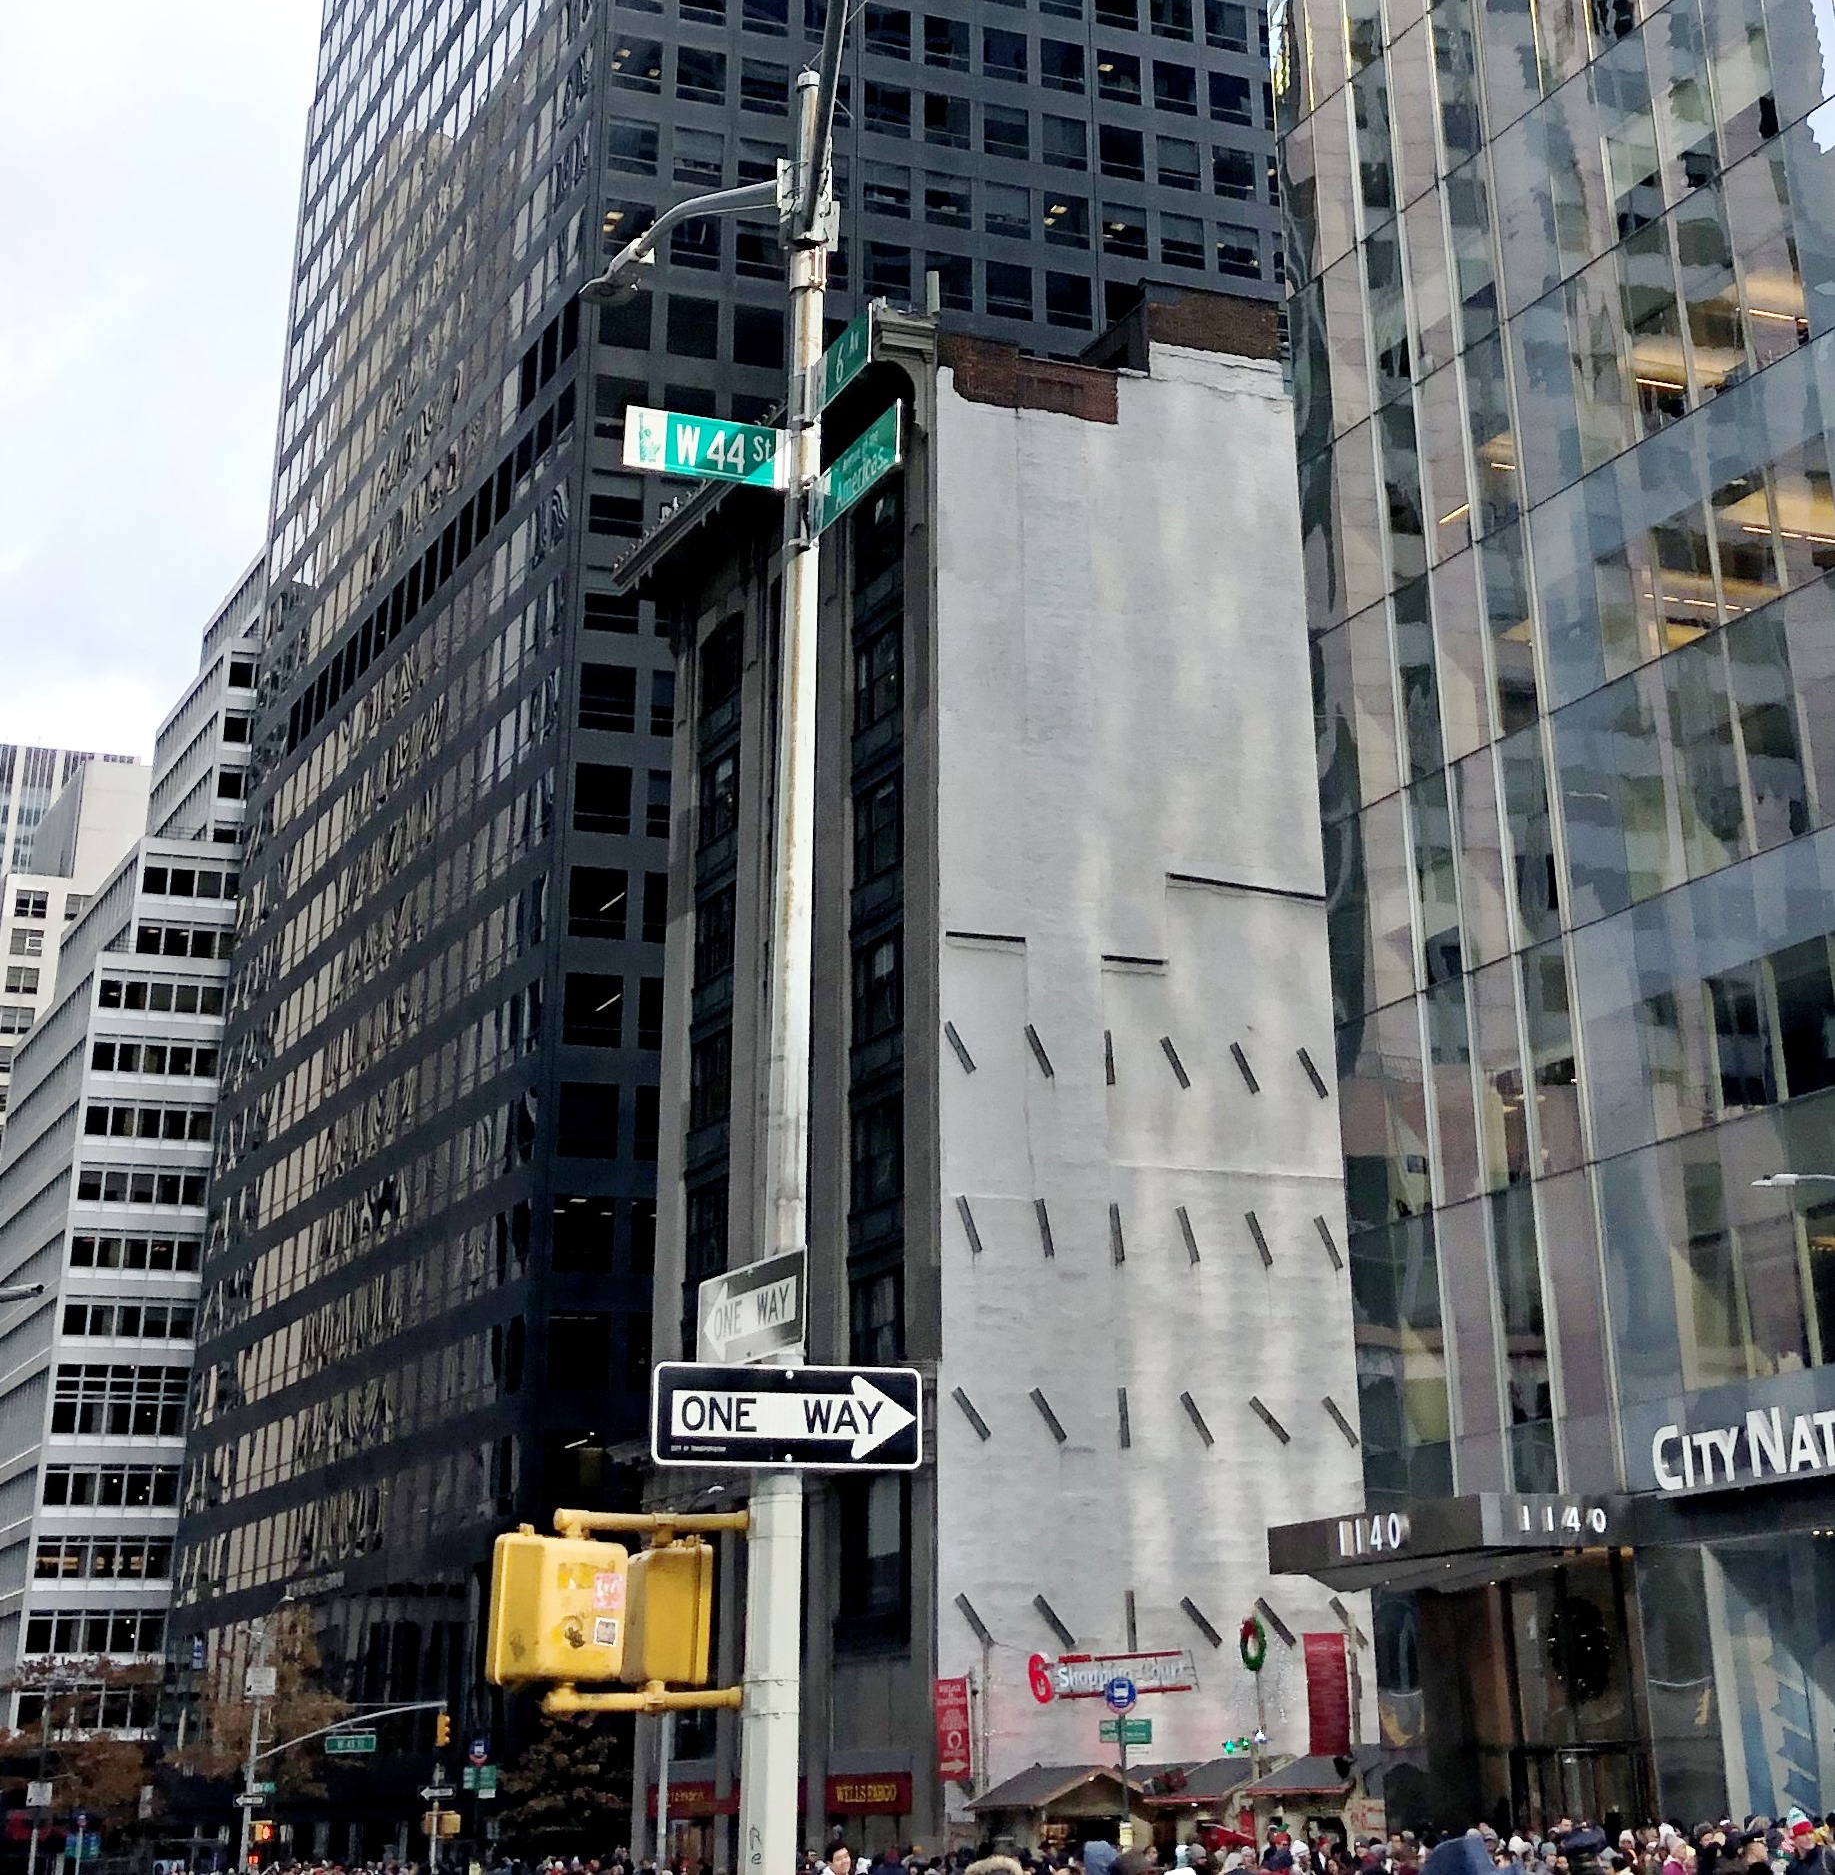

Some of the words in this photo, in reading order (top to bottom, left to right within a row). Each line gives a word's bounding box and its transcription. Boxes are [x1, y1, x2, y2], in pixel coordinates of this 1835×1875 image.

[835, 342, 845, 384] 6
[676, 423, 701, 467] W
[705, 429, 746, 474] 44
[752, 435, 773, 463] St
[835, 446, 889, 511] Americas
[714, 1299, 743, 1341] ONE
[756, 1283, 790, 1326] WAY
[681, 1396, 758, 1433] ONE
[803, 1399, 885, 1435] WAY
[1338, 1512, 1402, 1557] 1140
[1520, 1505, 1607, 1533] 1140
[835, 1785, 867, 1803] WELLS
